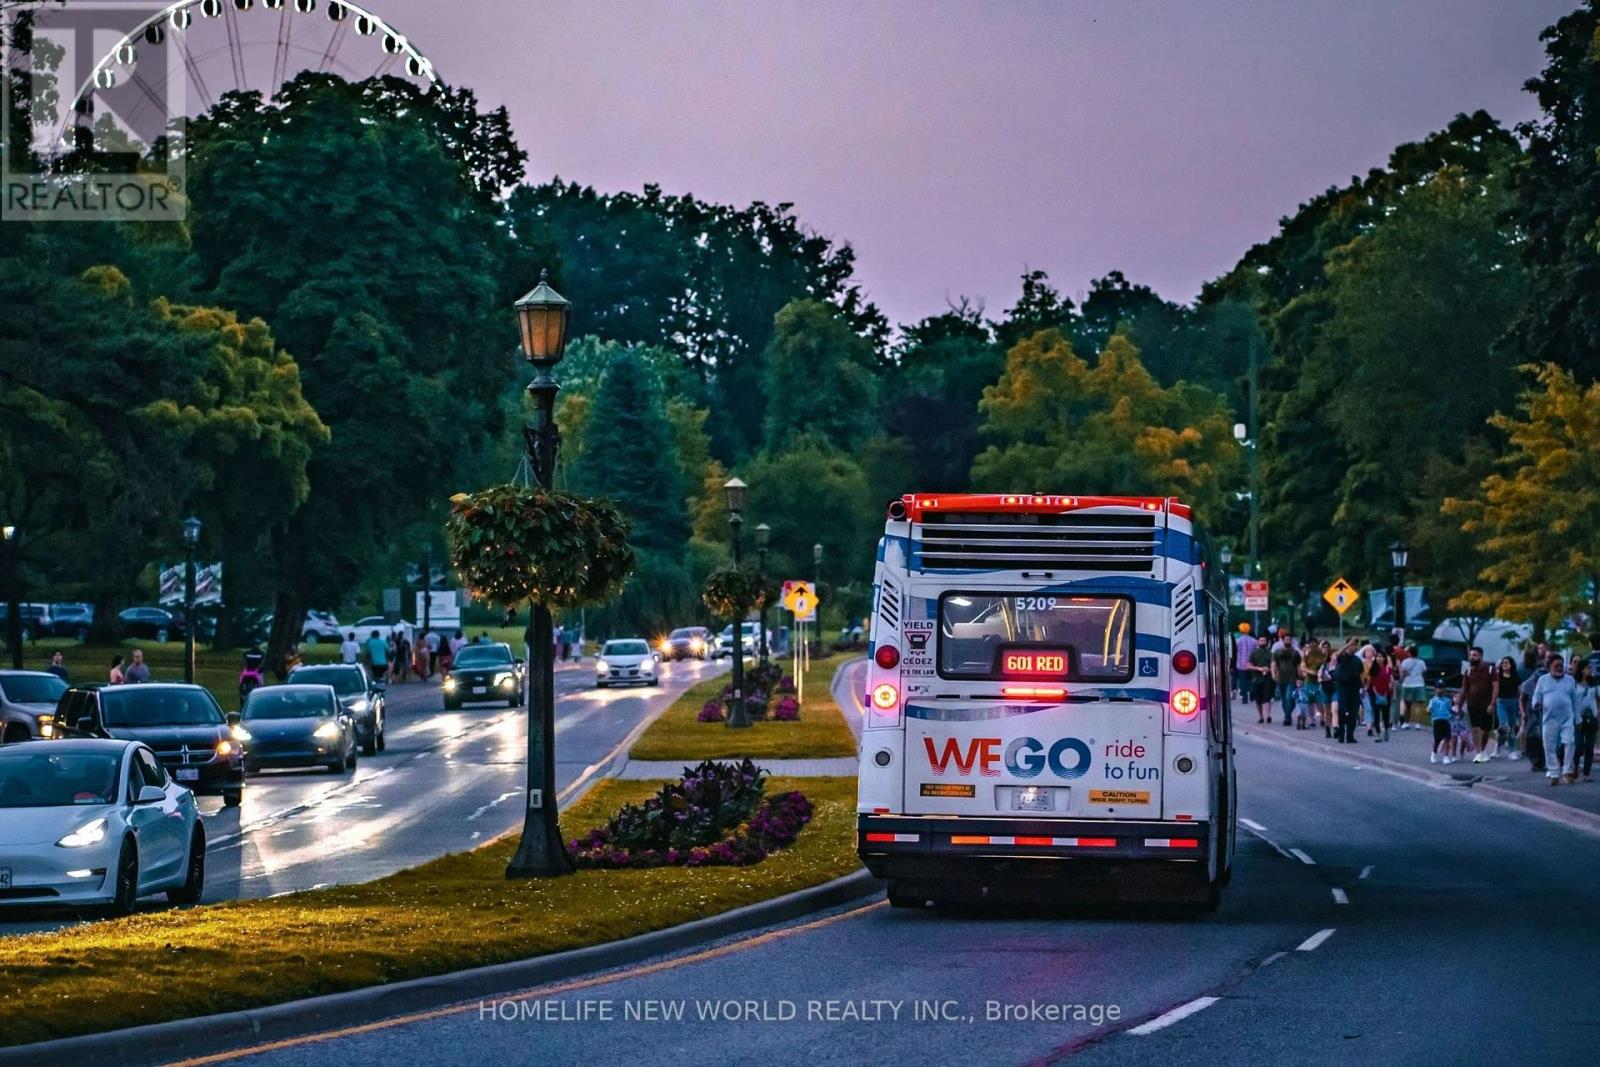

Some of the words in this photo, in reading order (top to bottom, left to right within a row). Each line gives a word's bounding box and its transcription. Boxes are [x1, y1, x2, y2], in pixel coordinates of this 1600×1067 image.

[1016, 597, 1057, 611] 5209
[903, 621, 934, 629] YIELD
[902, 657, 933, 665] CÉDEZ
[1007, 656, 1033, 671] 601
[1036, 656, 1064, 671] RED
[1105, 739, 1145, 758] ride
[1105, 763, 1122, 780] to
[1128, 761, 1159, 780] fun
